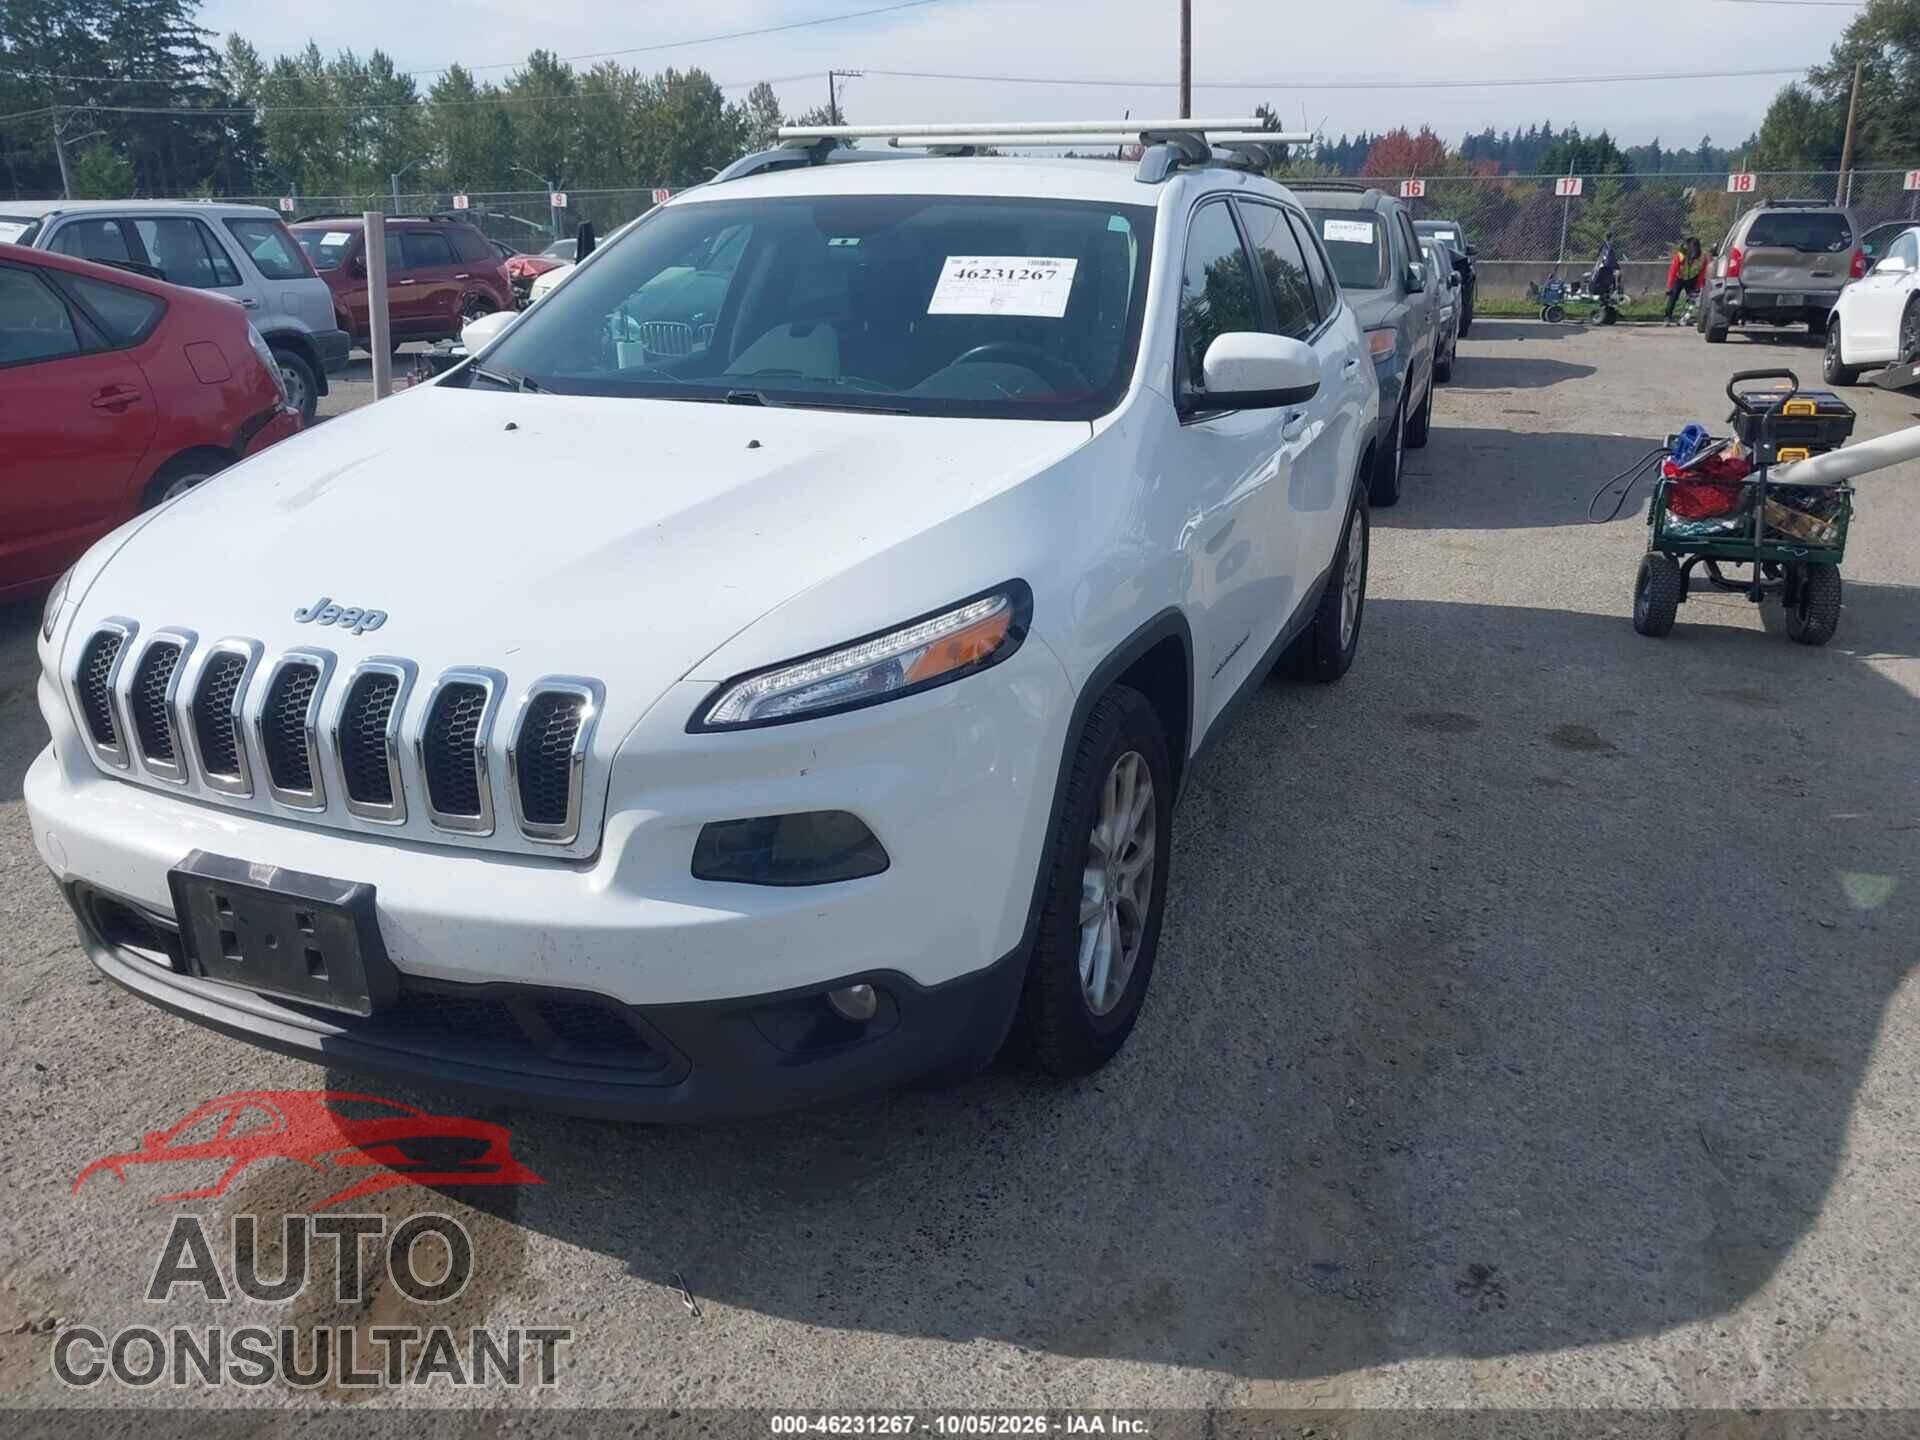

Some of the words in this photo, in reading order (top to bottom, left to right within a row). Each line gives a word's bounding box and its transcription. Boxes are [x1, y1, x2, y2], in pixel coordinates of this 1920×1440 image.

[1562, 180, 1576, 194] 17
[1733, 175, 1750, 190] 18
[1911, 172, 1920, 188] 1
[1407, 181, 1420, 196] 16
[555, 194, 561, 205] 9
[656, 190, 667, 202] 10
[953, 268, 1057, 281] 46231267
[294, 597, 388, 636] Jeep
